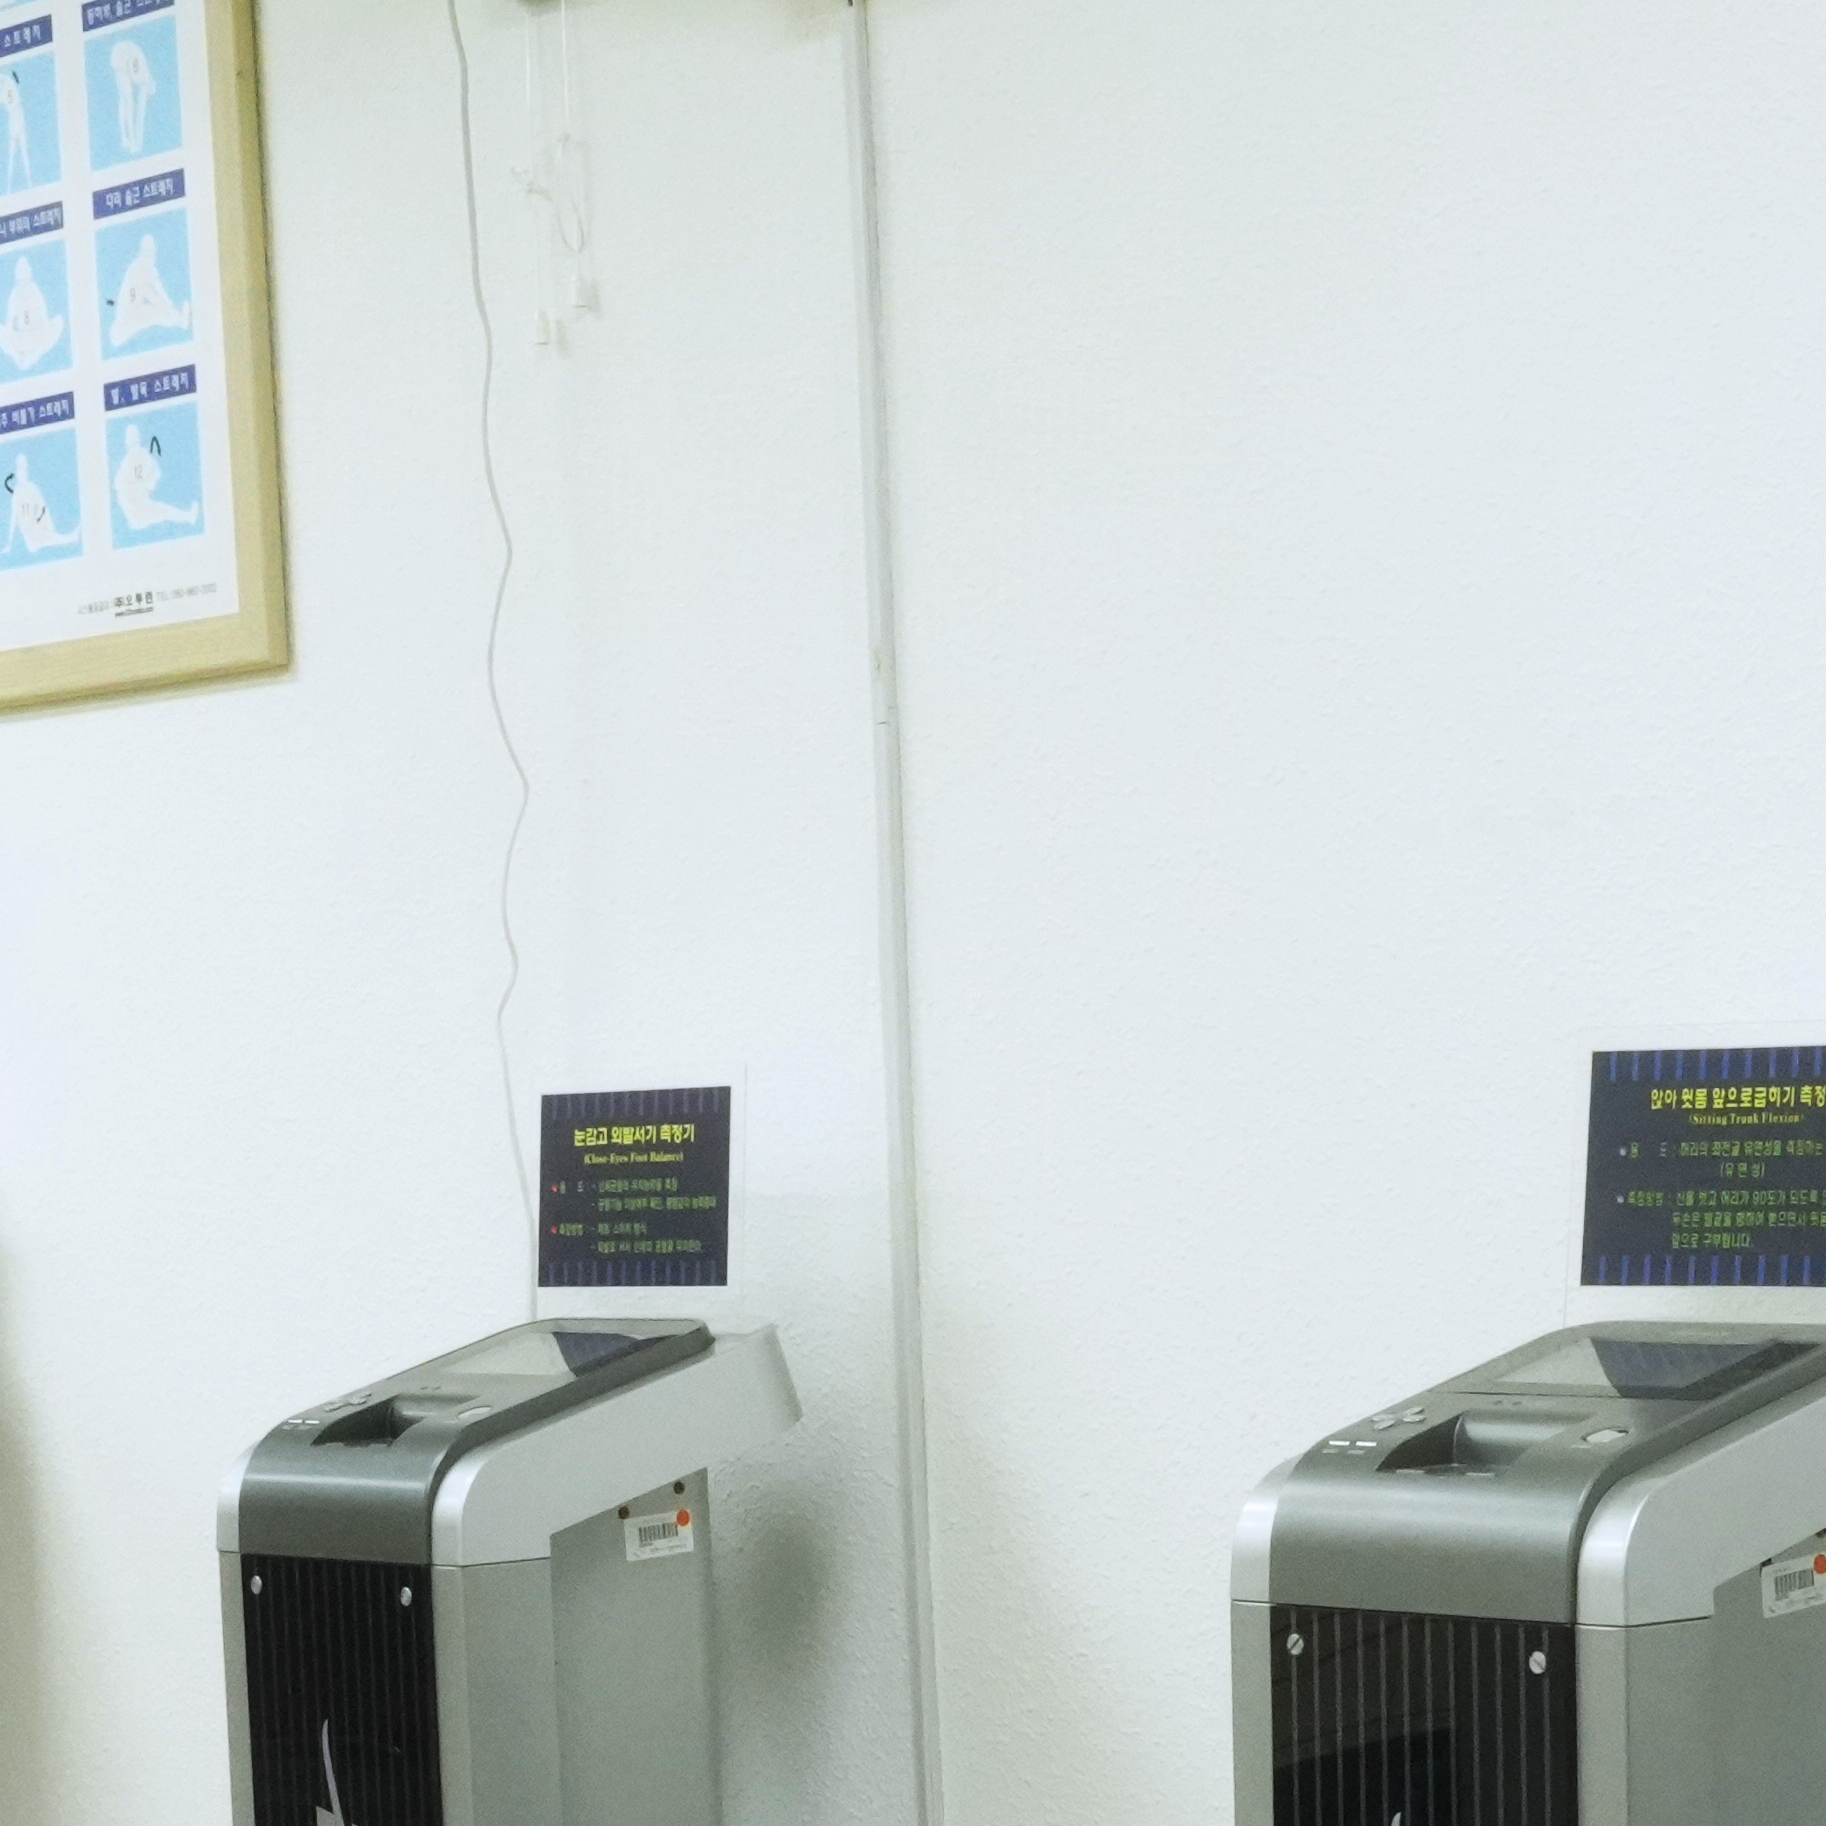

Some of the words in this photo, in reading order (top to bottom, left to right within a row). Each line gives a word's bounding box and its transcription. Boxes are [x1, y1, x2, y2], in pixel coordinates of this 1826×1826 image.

[1651, 1089, 1677, 1110] 앉아
[1681, 1088, 1707, 1109] 윗몸
[574, 1127, 608, 1146] 눈감고
[611, 1125, 657, 1145] 외발서기
[660, 1123, 694, 1143] 측정기
